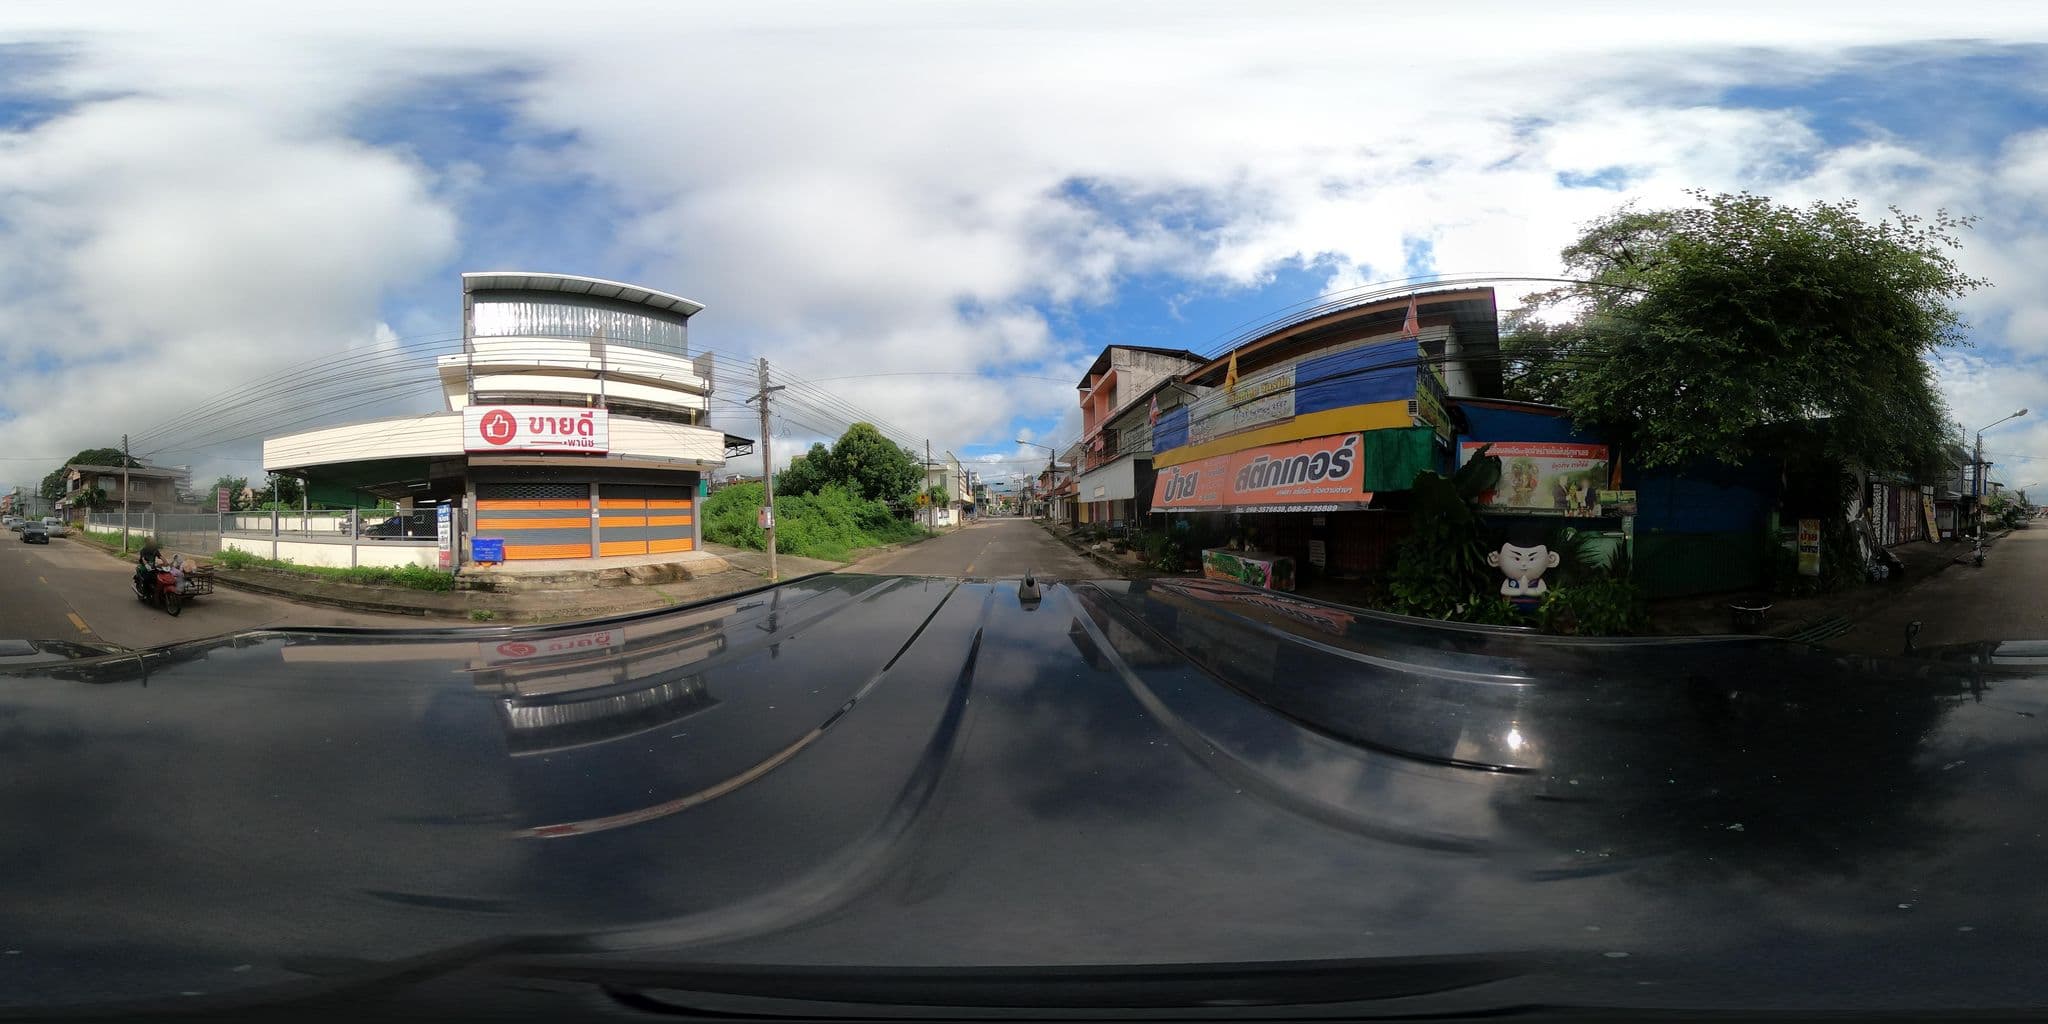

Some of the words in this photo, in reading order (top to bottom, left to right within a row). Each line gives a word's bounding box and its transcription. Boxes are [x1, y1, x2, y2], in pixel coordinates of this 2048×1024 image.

[529, 411, 594, 436] ขายดี
[567, 437, 594, 447] พานิช
[1163, 466, 1200, 503] ป้าย
[1235, 435, 1358, 492] สติกเกอร์
